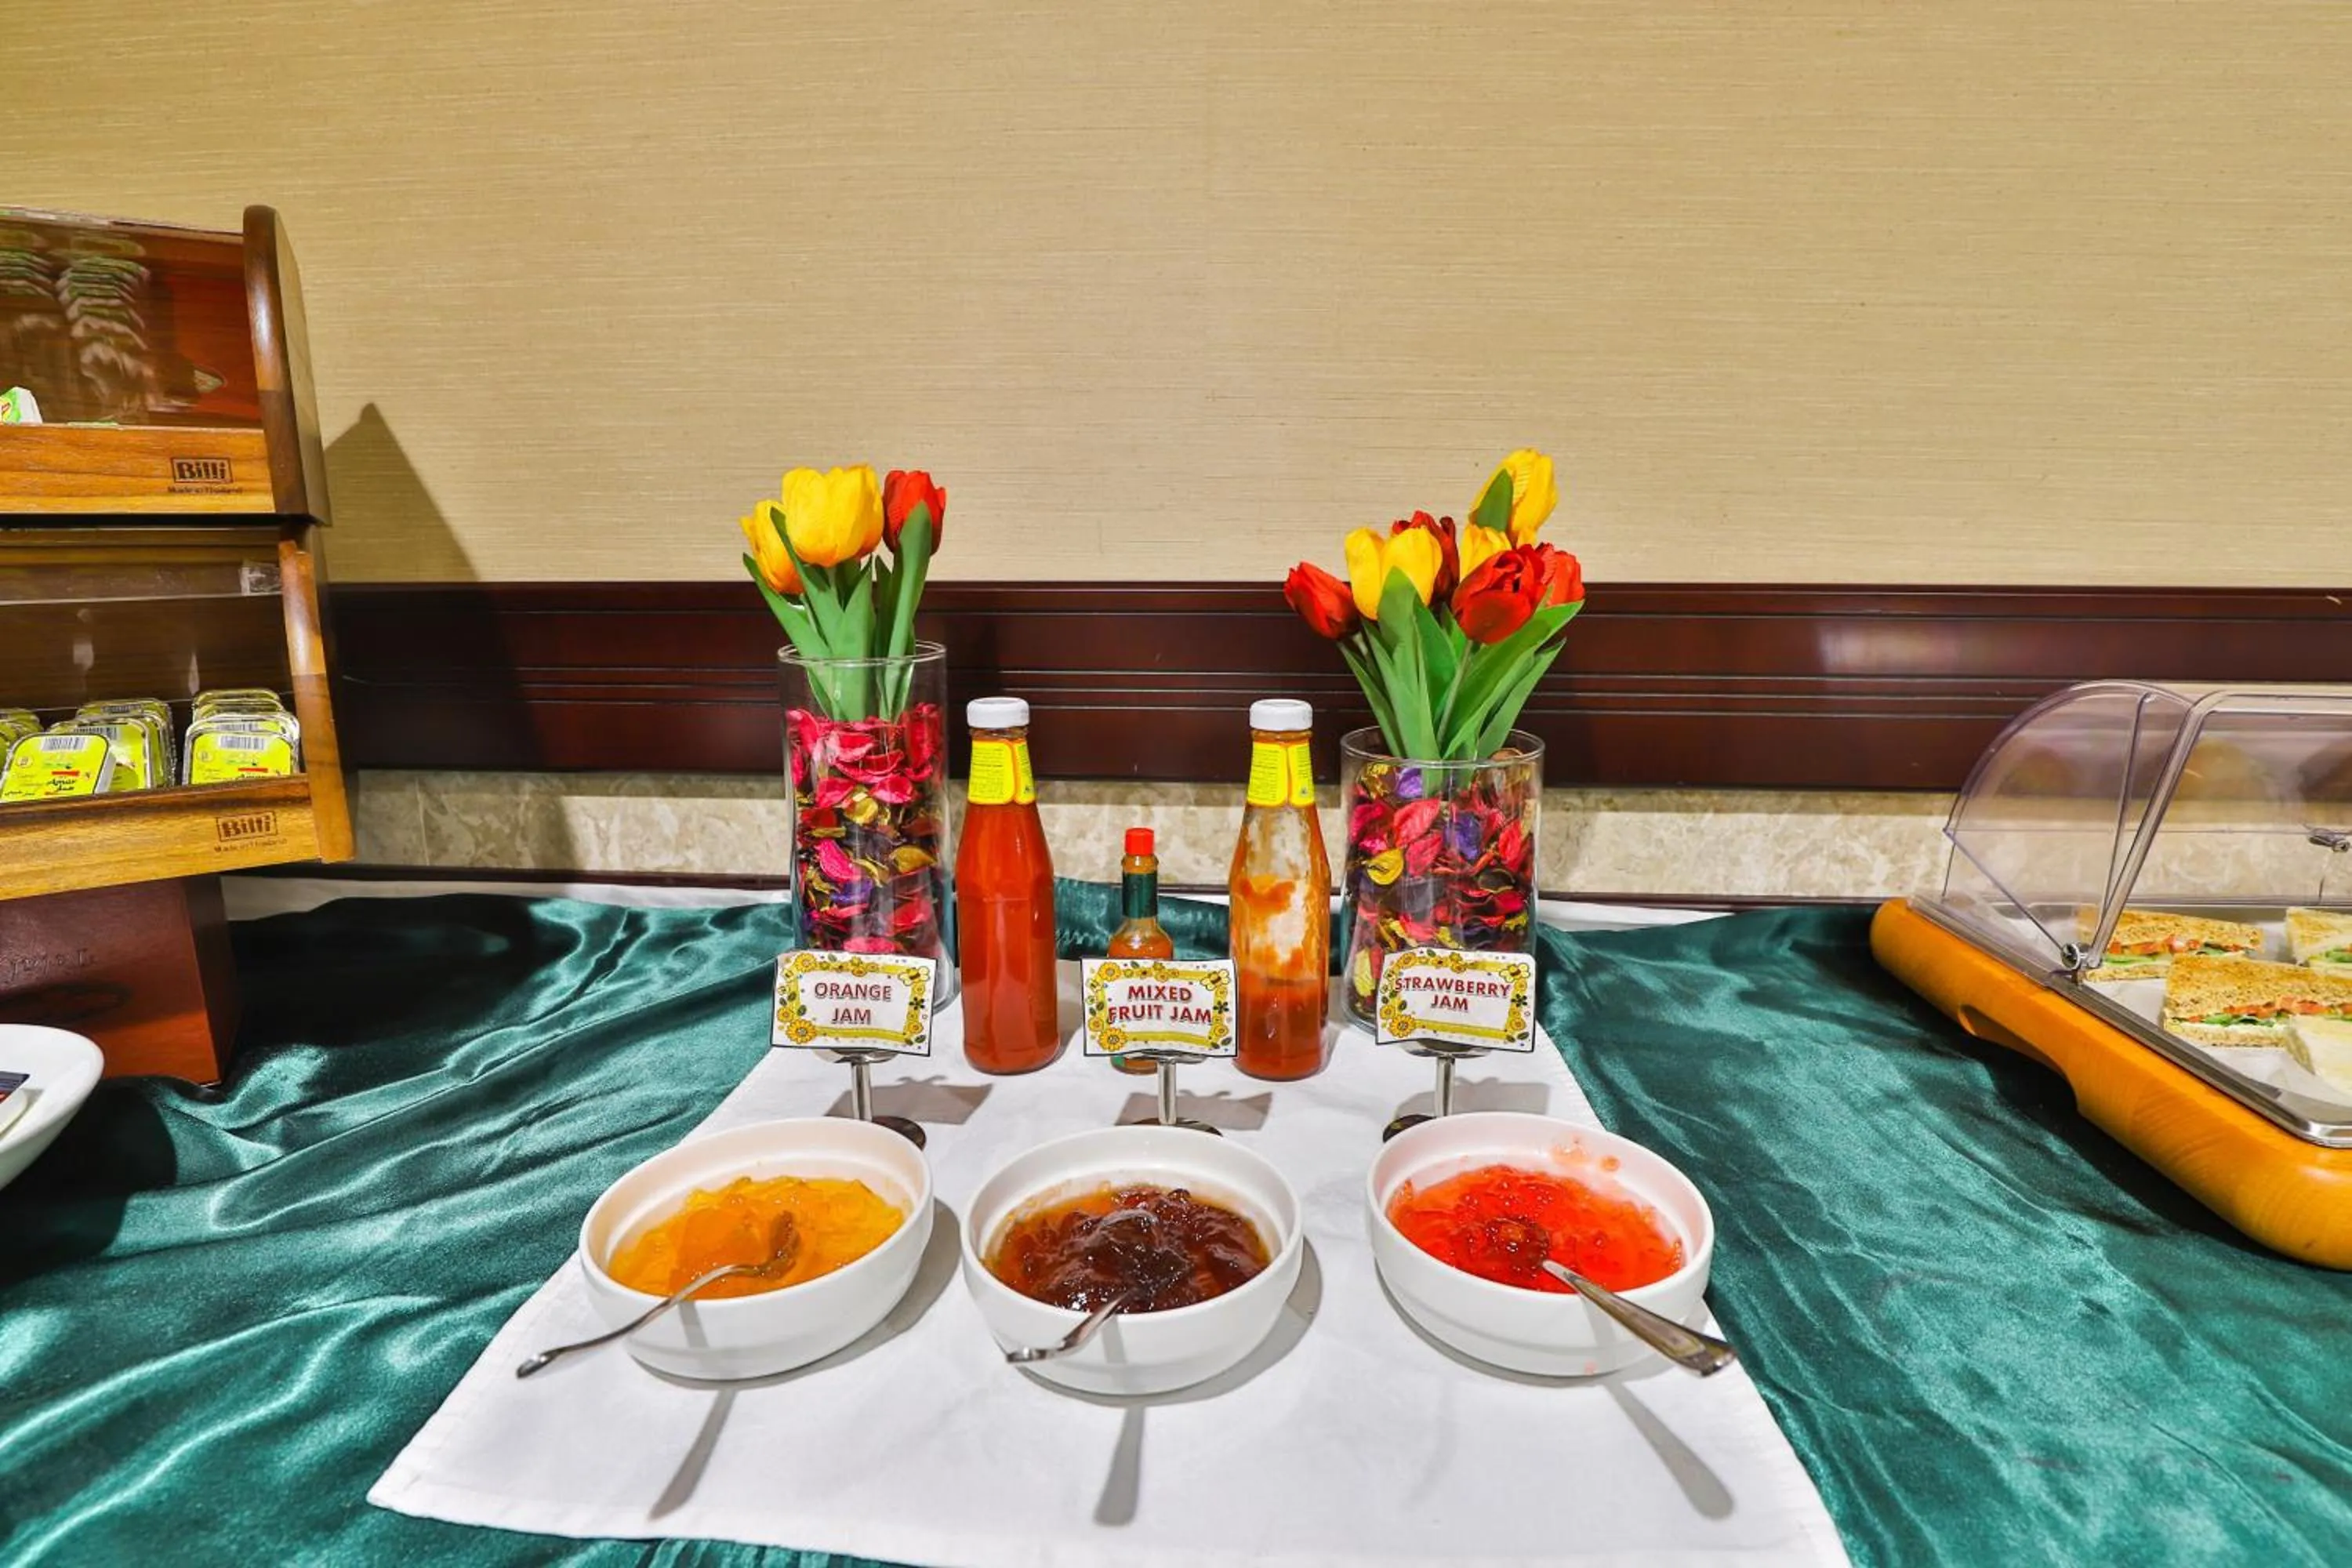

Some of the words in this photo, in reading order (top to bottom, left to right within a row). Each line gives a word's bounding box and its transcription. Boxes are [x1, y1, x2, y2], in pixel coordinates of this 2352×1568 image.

[176, 462, 227, 479] Billi
[222, 815, 270, 837] Billi
[815, 982, 892, 1000] ORANGE
[1127, 985, 1192, 1002] MIXED
[1395, 975, 1511, 996] STRAWBERRY
[1431, 994, 1468, 1011] JAM
[832, 1007, 872, 1023] JAM
[1108, 1004, 1165, 1023] FRUIT
[1170, 1006, 1212, 1023] JAM
